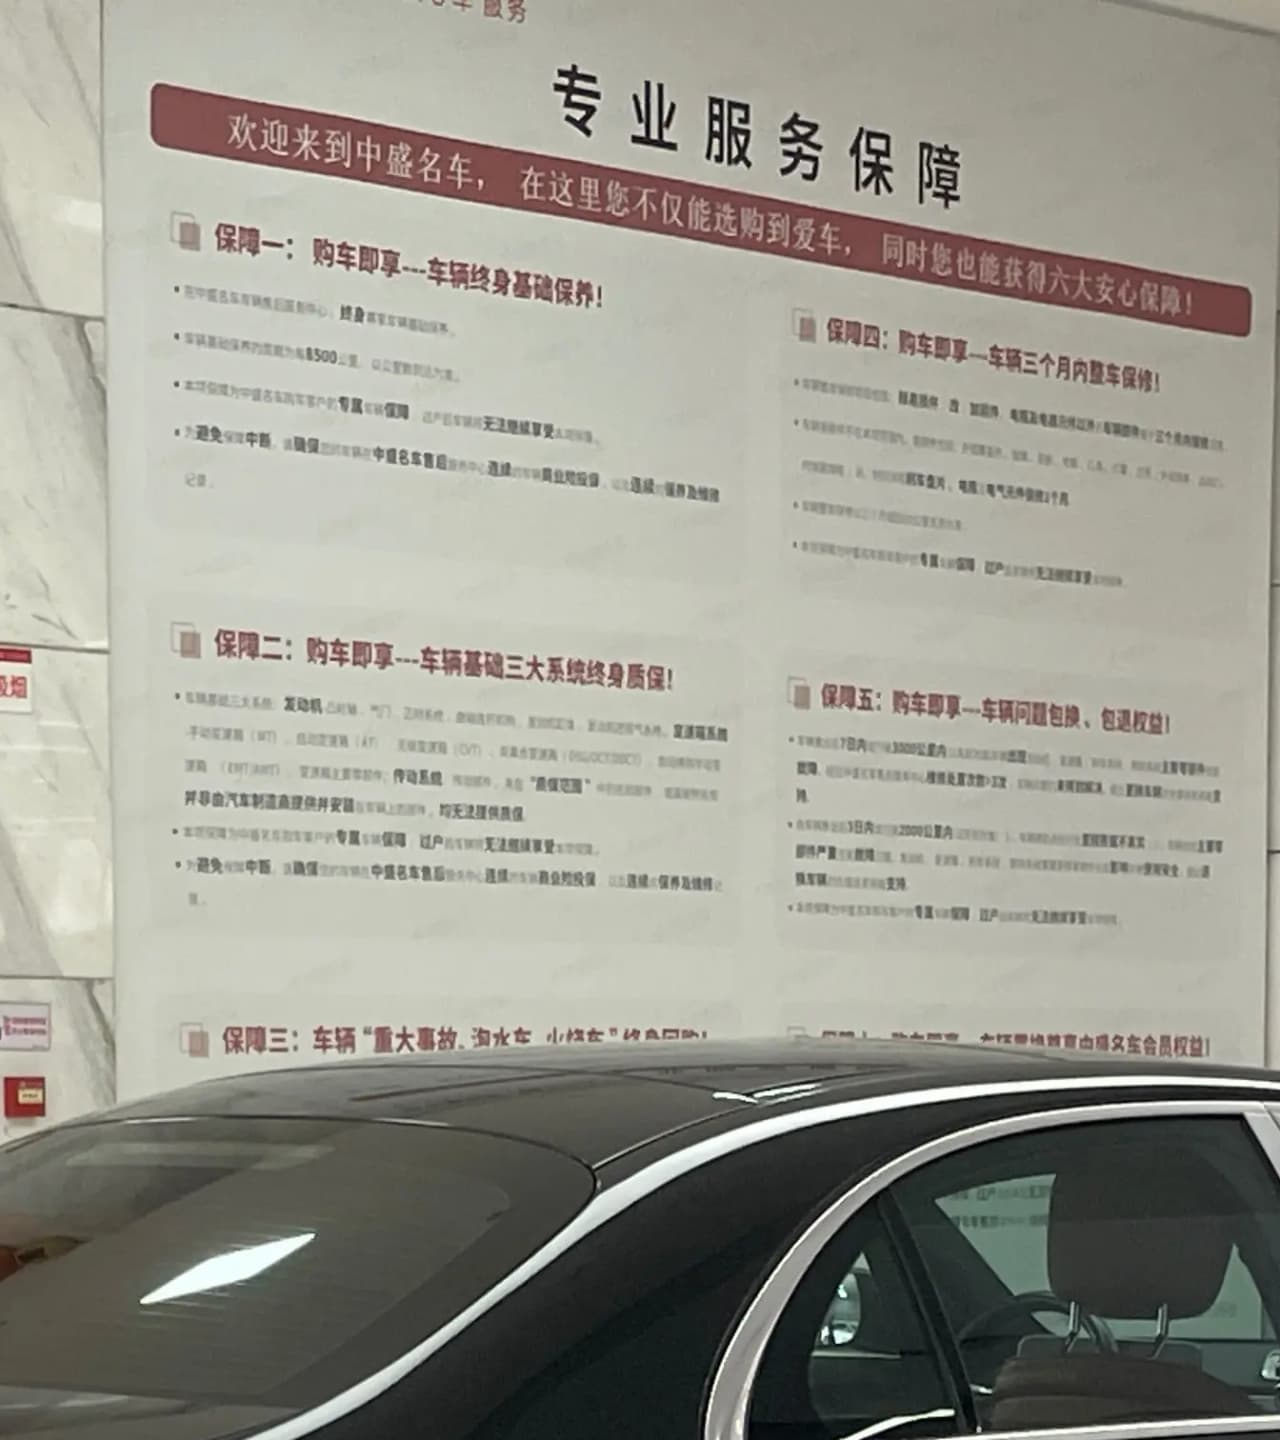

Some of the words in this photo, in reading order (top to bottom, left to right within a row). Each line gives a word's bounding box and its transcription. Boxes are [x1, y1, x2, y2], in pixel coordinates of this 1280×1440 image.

[553, 64, 961, 209] 专业服务保障
